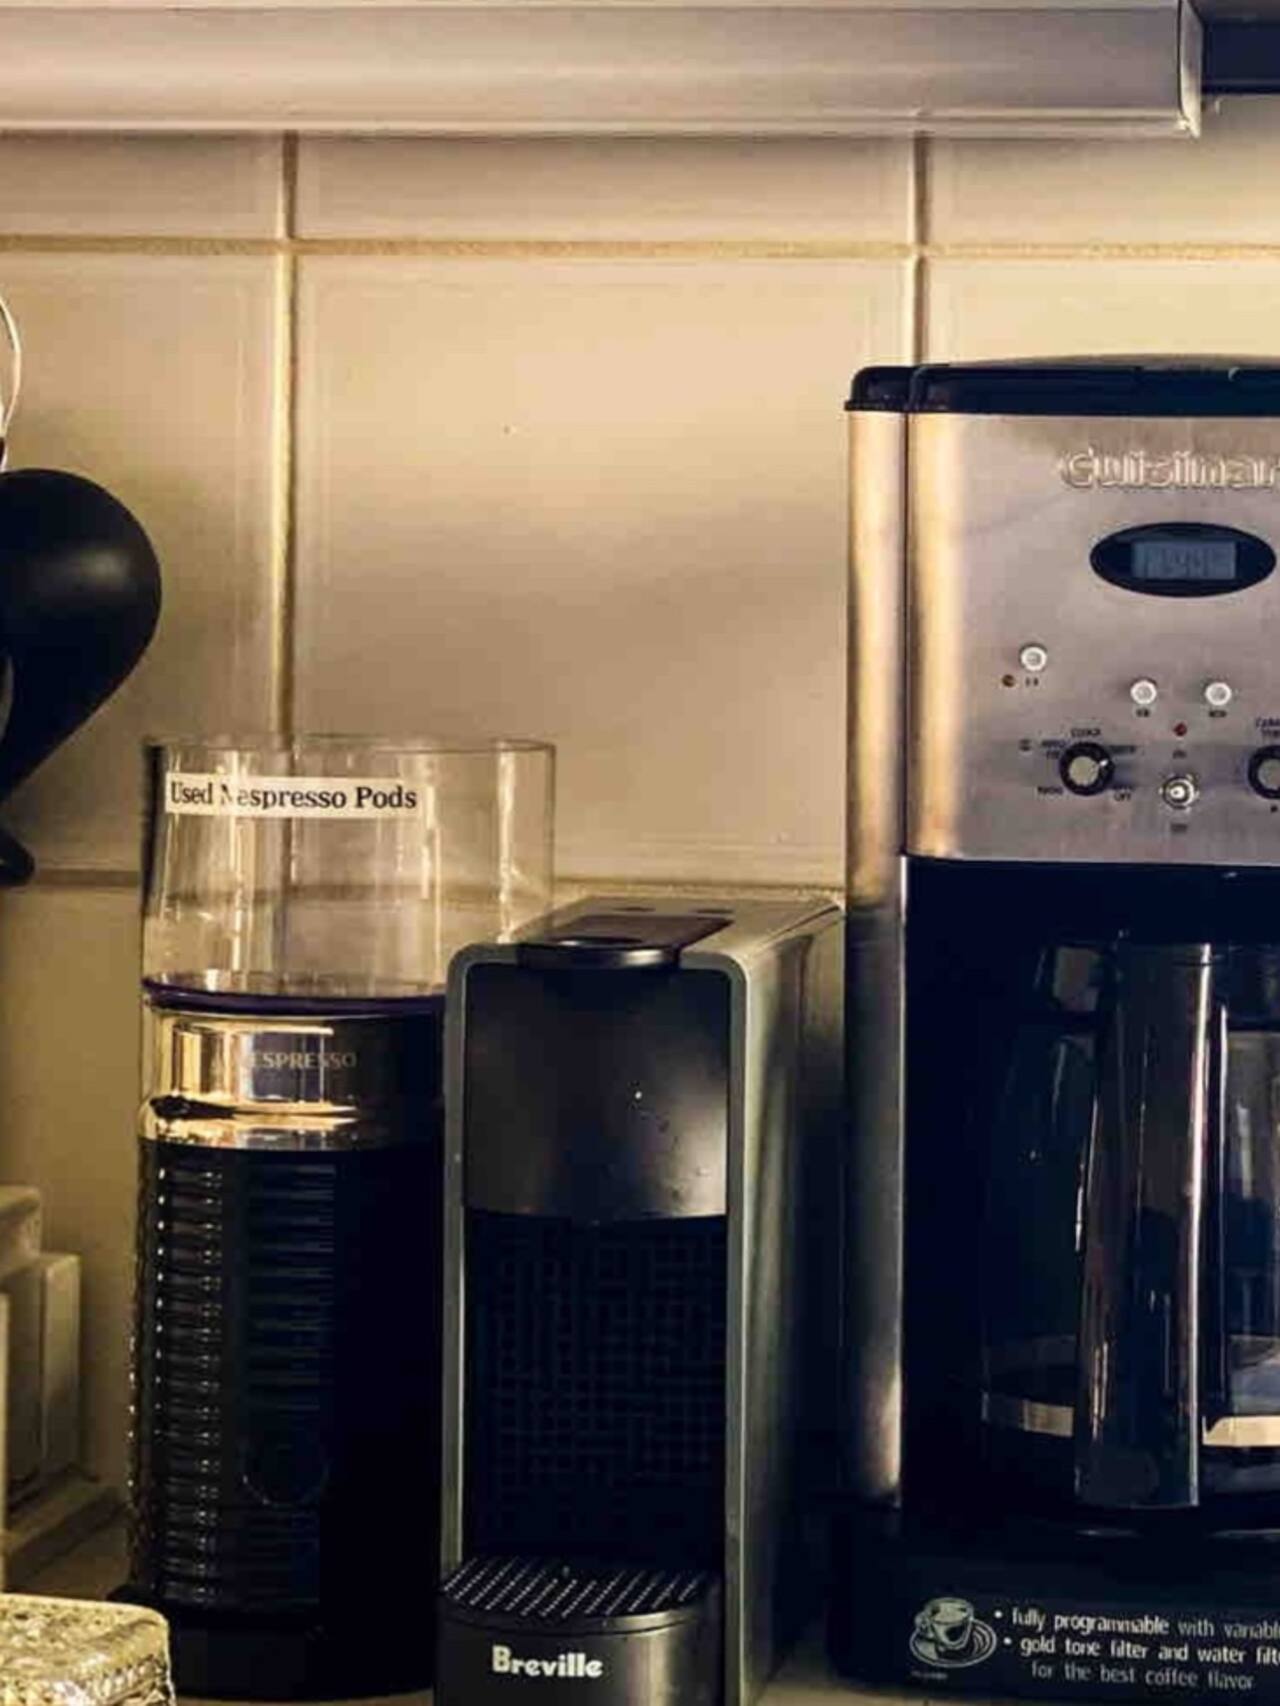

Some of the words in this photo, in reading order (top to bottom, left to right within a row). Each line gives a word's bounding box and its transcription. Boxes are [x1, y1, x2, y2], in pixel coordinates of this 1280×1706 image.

[170, 780, 213, 805] Used
[221, 784, 346, 809] Nespresso
[356, 785, 417, 809] Pods
[242, 1051, 357, 1069] ESPRESSO
[1012, 1606, 1046, 1632] fully
[1054, 1613, 1170, 1635] programmable
[1178, 1618, 1215, 1638] with
[492, 1644, 603, 1677] Breville
[1020, 1636, 1056, 1656] gold
[1065, 1638, 1101, 1656] tone
[1110, 1640, 1149, 1660] filter
[1158, 1644, 1190, 1661] and
[1198, 1647, 1247, 1664] water
[1031, 1661, 1053, 1679] for
[1064, 1662, 1092, 1682] the
[1101, 1666, 1136, 1684] best
[1145, 1667, 1200, 1687] coffee
[1207, 1668, 1255, 1691] flavor
